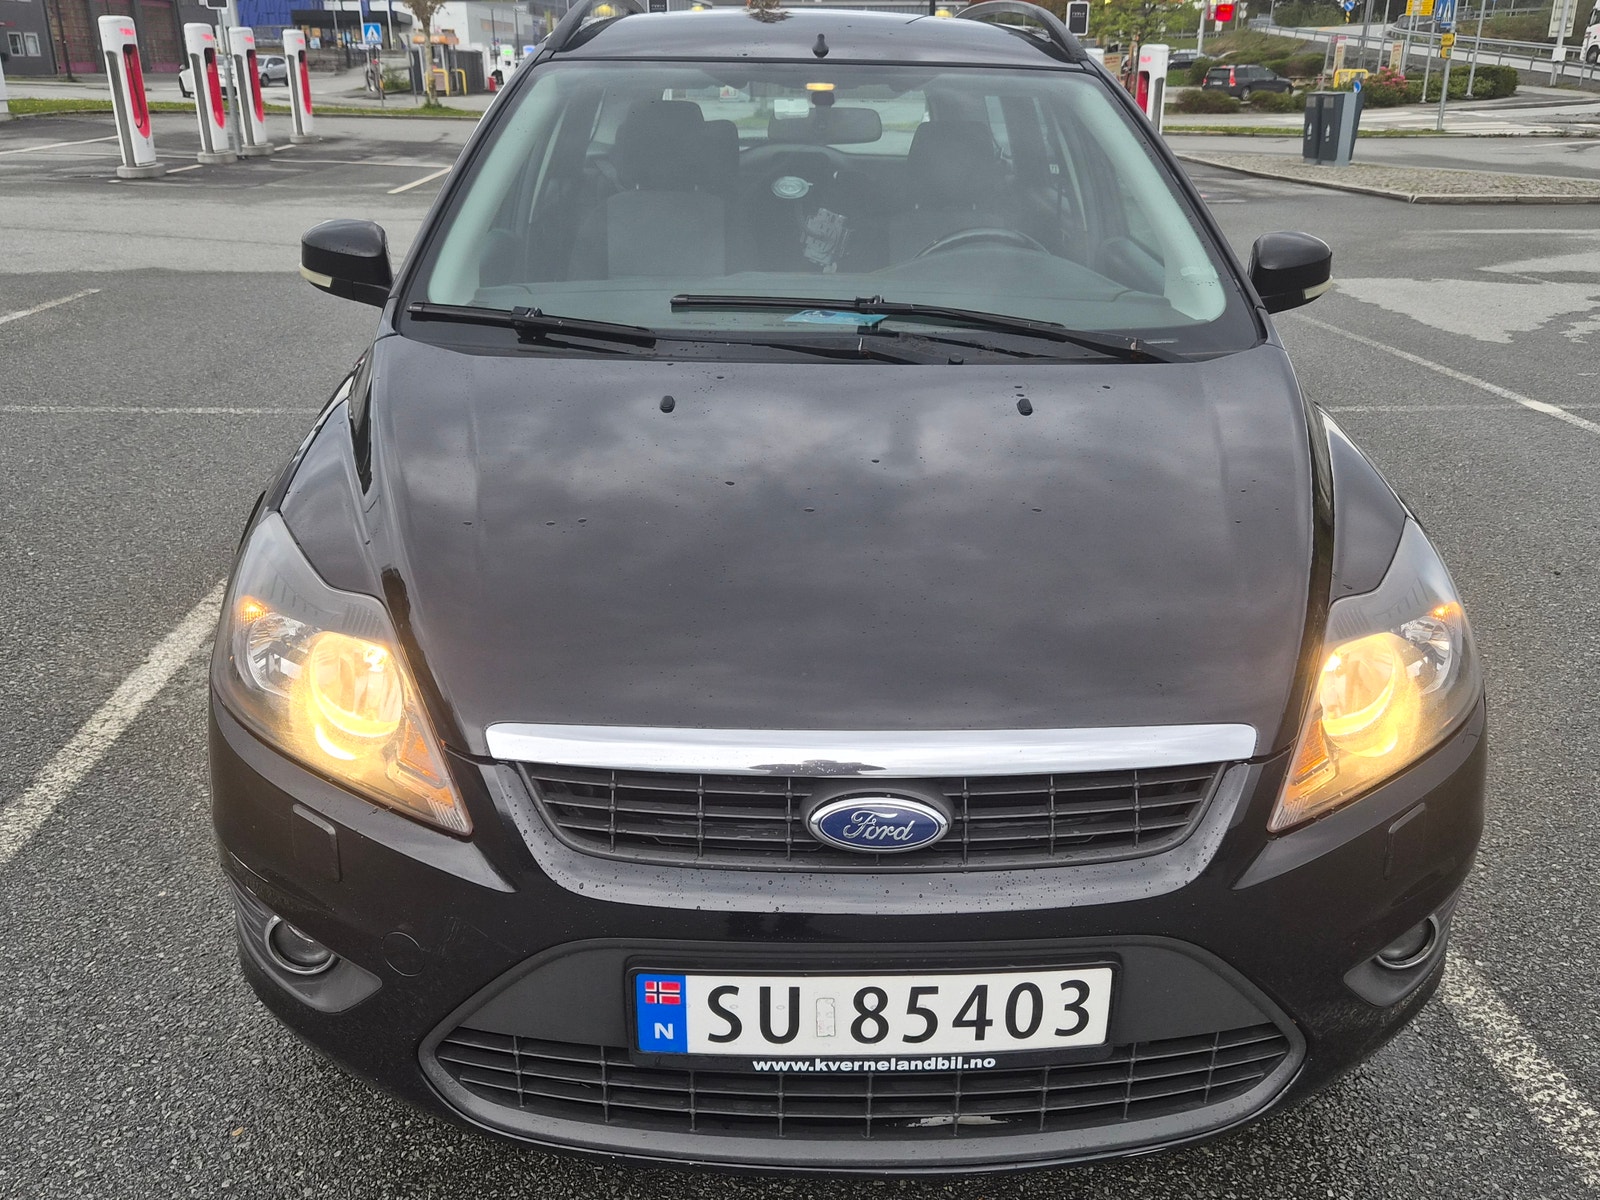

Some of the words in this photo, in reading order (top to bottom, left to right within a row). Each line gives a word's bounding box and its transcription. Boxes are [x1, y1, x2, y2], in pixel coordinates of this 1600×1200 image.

[842, 810, 916, 841] Ford
[707, 984, 801, 1044] SU
[850, 979, 1091, 1045] 85403
[653, 1022, 675, 1040] N
[752, 1056, 997, 1072] www.kvernelandbil.no
